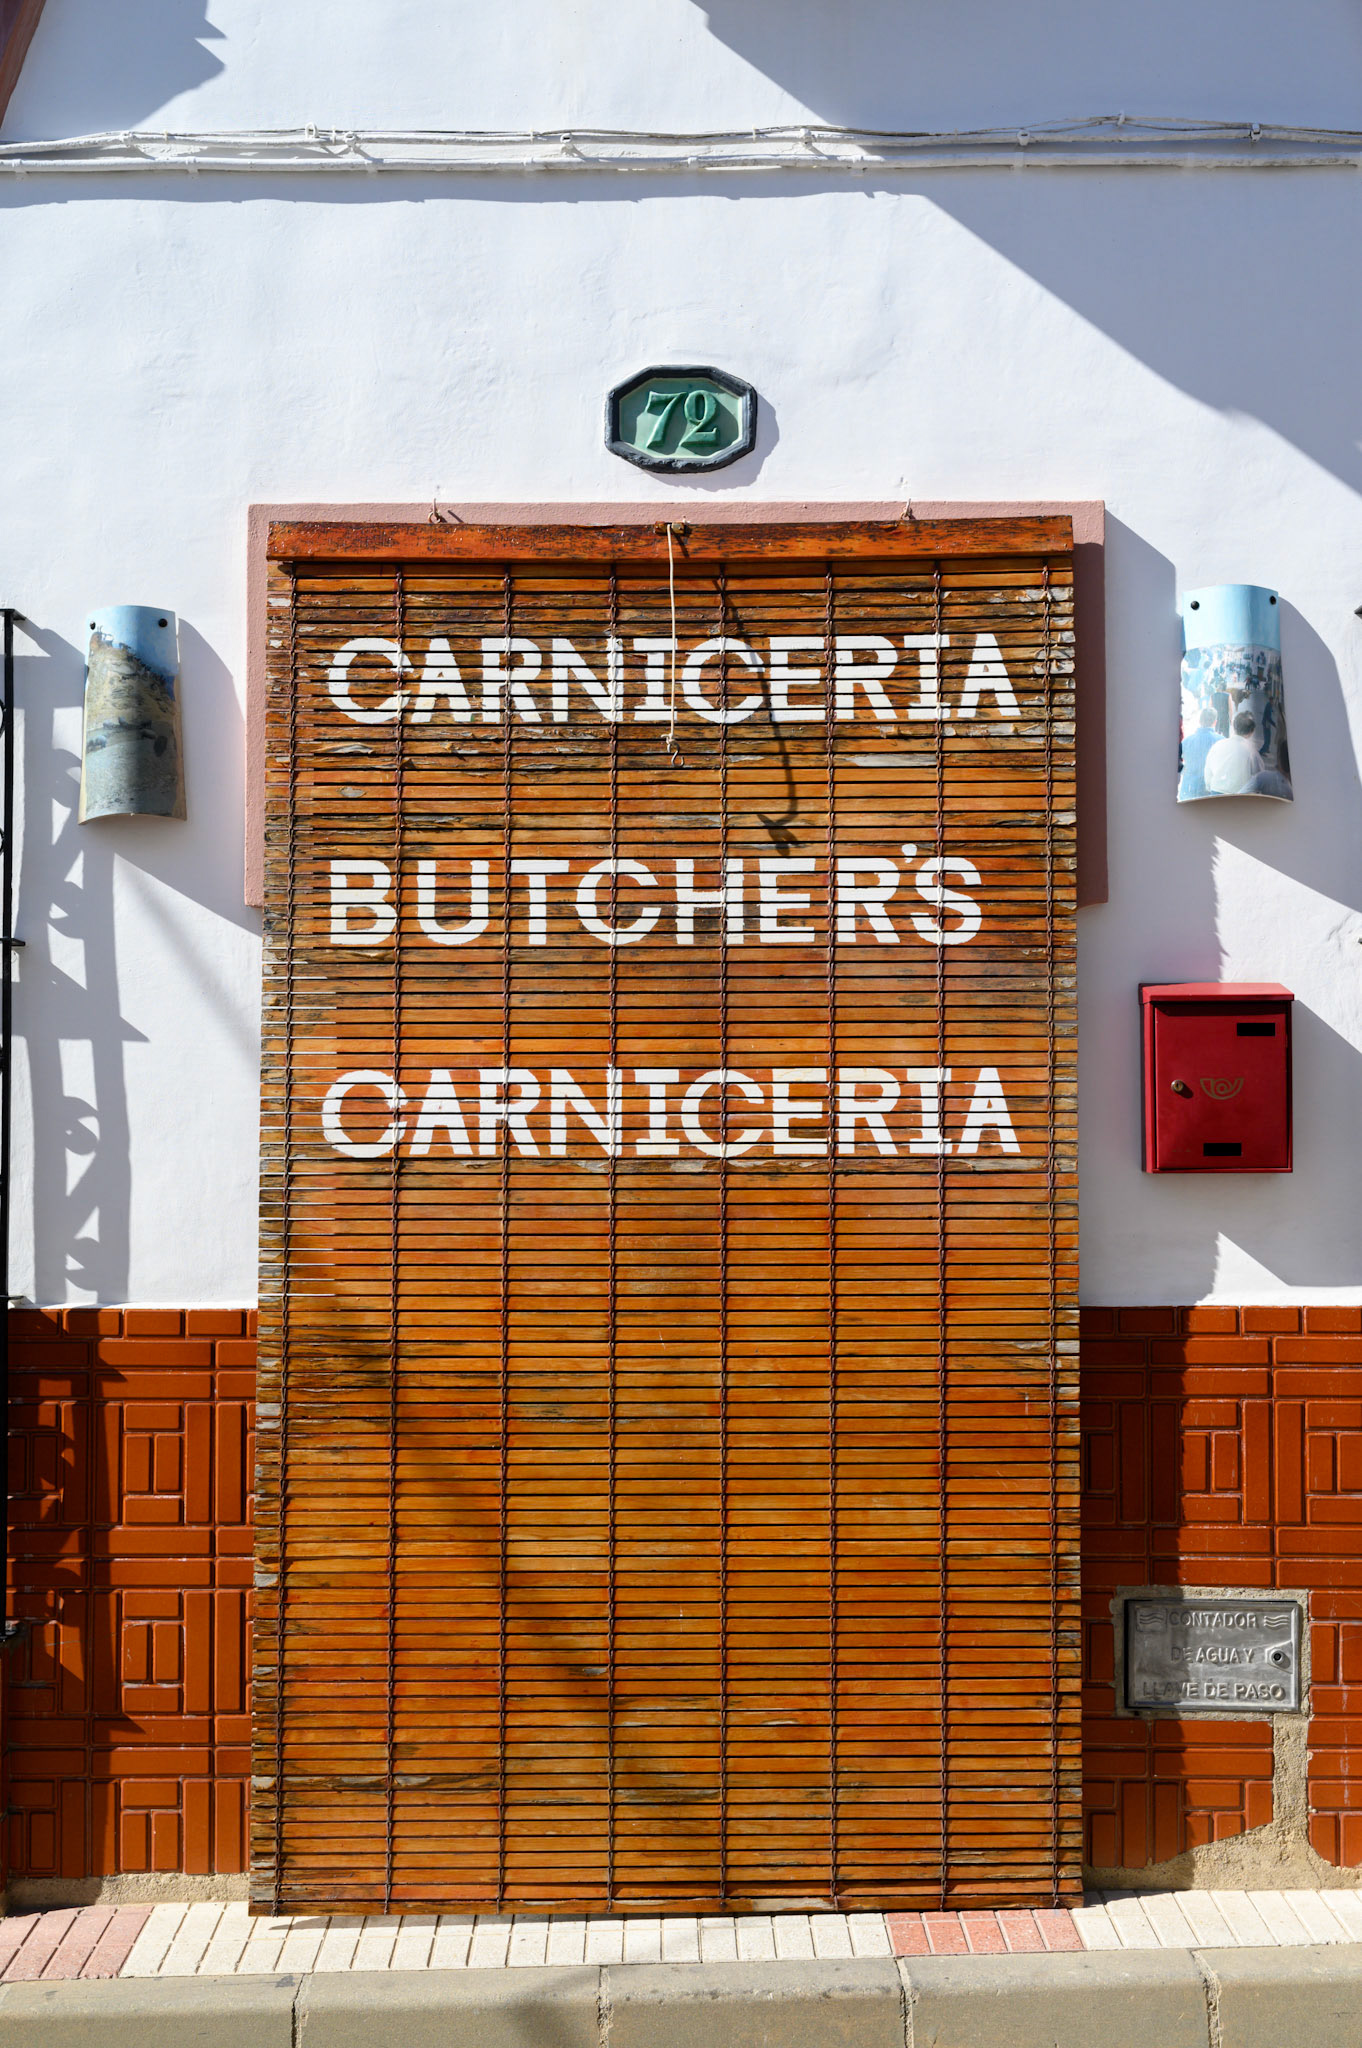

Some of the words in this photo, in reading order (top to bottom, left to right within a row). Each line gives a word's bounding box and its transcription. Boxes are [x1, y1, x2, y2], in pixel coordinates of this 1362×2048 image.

[646, 390, 718, 448] 72
[327, 633, 1022, 724] CARNICERIA
[330, 843, 983, 945] BUTCHER'S
[321, 1066, 1021, 1158] CARNICERIA
[1169, 1611, 1257, 1629] CONTADOR
[1171, 1646, 1193, 1664] DE
[1143, 1682, 1199, 1699] LLAVE
[1204, 1682, 1228, 1699] DE
[1234, 1683, 1286, 1701] PASO
